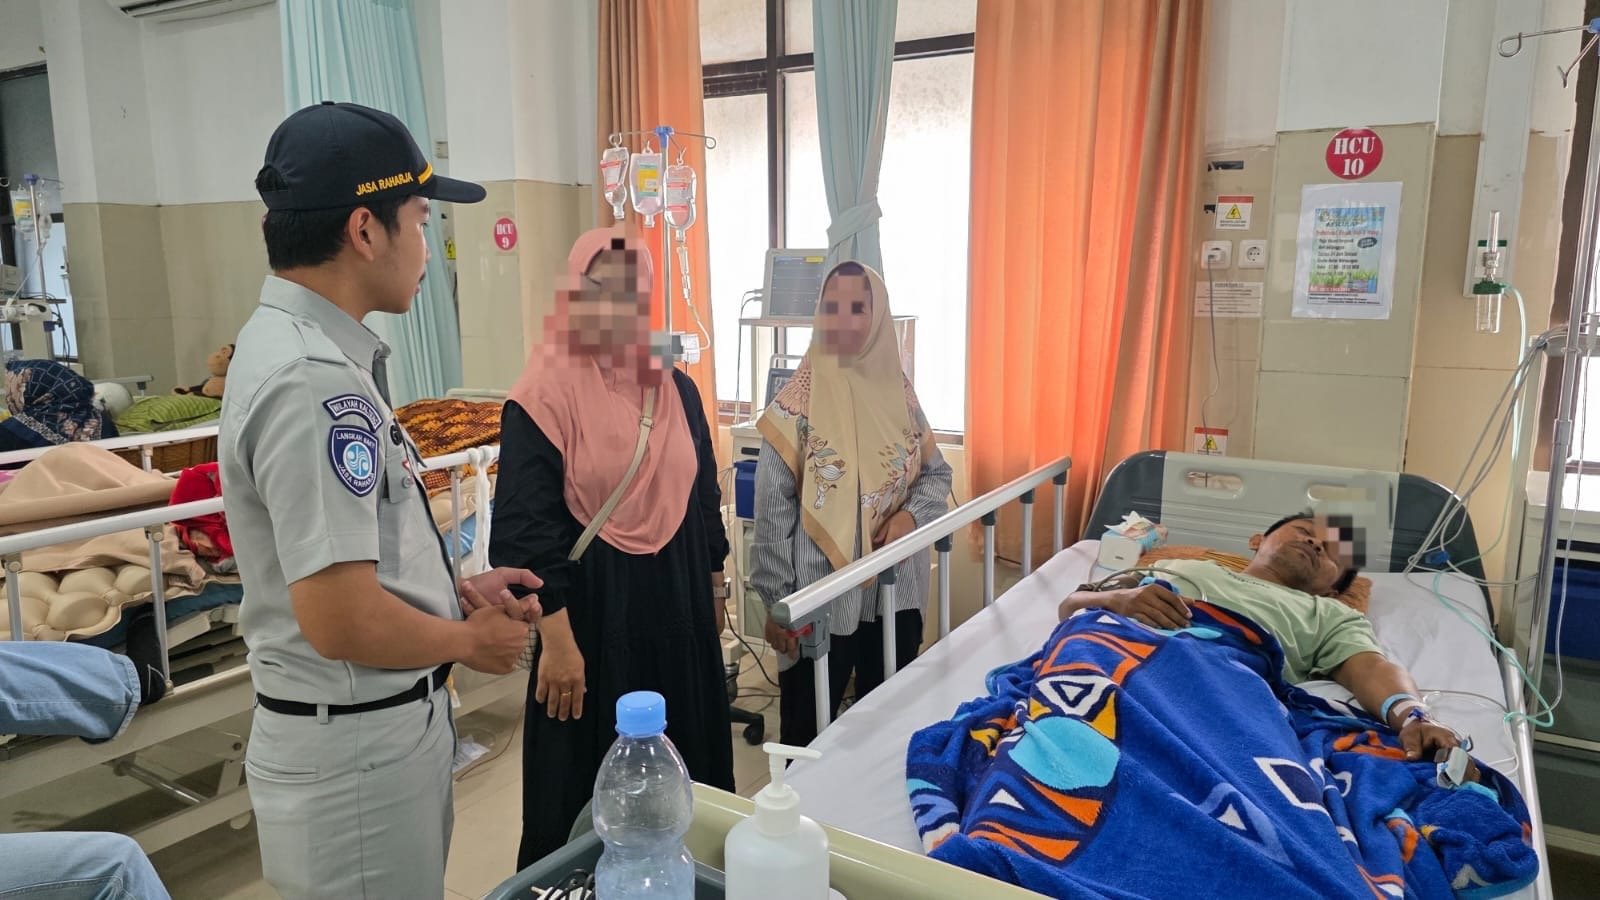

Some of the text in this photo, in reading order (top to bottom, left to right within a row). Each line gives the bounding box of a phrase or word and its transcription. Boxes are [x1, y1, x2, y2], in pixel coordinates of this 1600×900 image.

[1333, 136, 1376, 155] HCU
[1342, 158, 1365, 176] 10
[355, 171, 414, 196] JASA RAHARJA
[496, 223, 513, 235] HCU
[502, 237, 510, 249] 9
[331, 399, 359, 413] WILAYAH
[336, 432, 362, 442] LANGKAH
[338, 463, 352, 483] JASA
